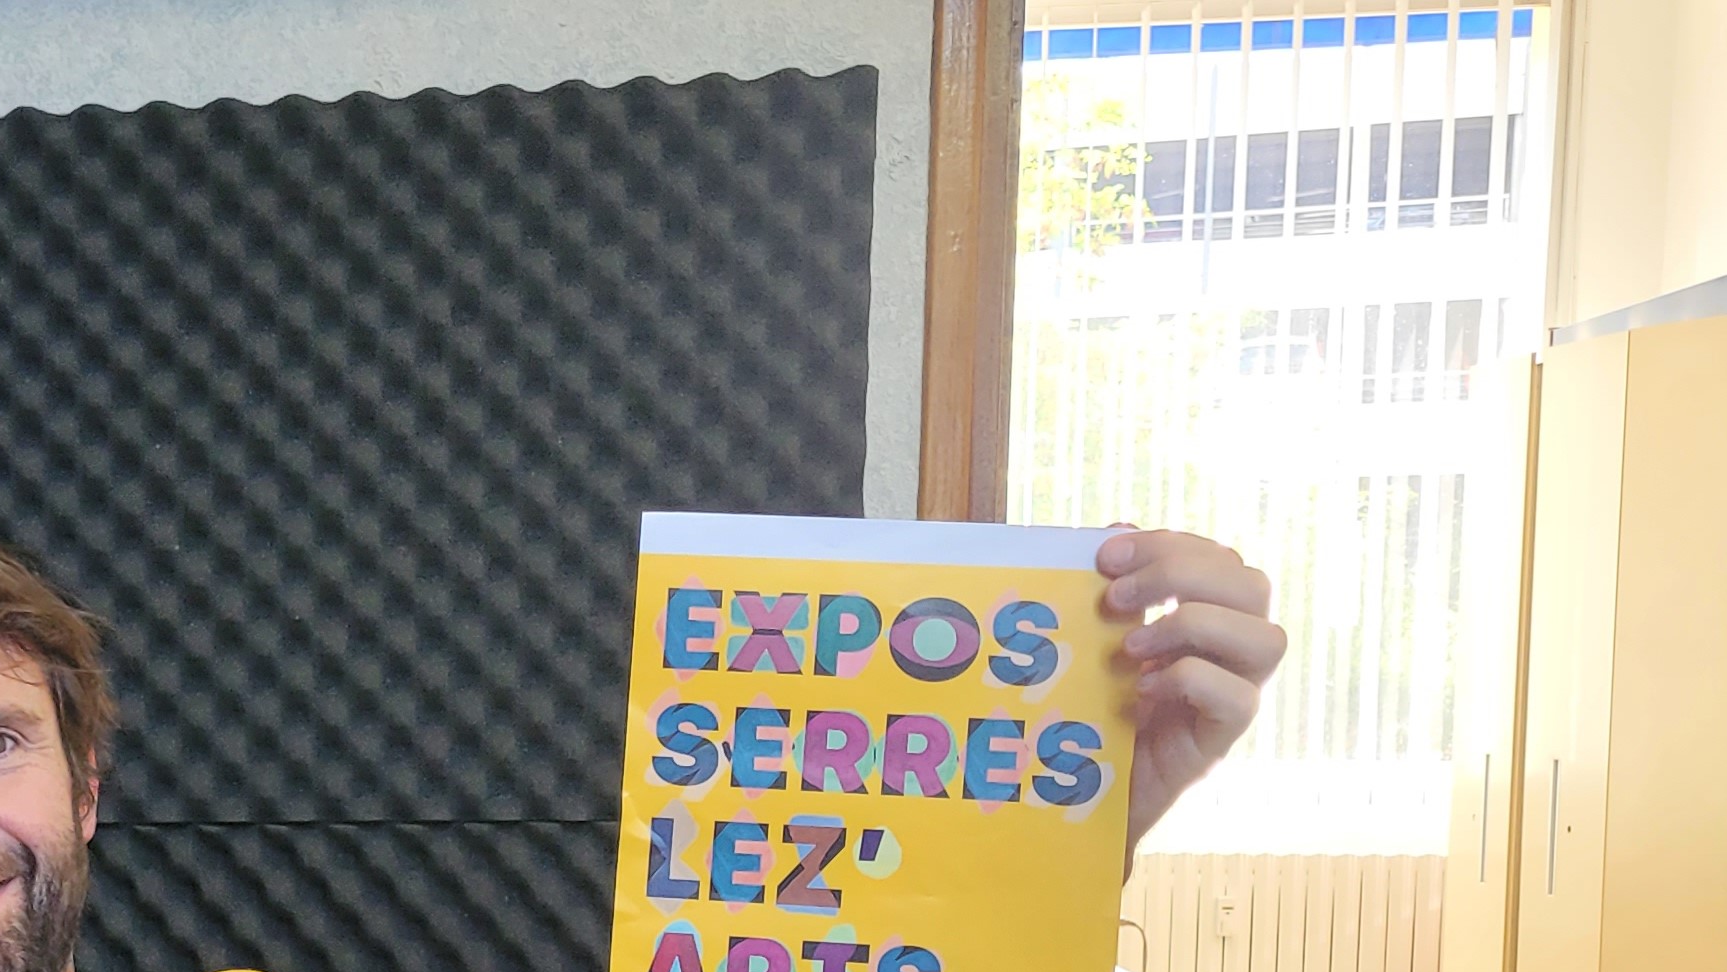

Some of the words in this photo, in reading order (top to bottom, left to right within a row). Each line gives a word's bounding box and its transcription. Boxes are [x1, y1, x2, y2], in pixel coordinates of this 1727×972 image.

[663, 587, 1059, 686] EXPOS
[652, 702, 1103, 806] SERRES
[646, 817, 885, 909] LEZ'
